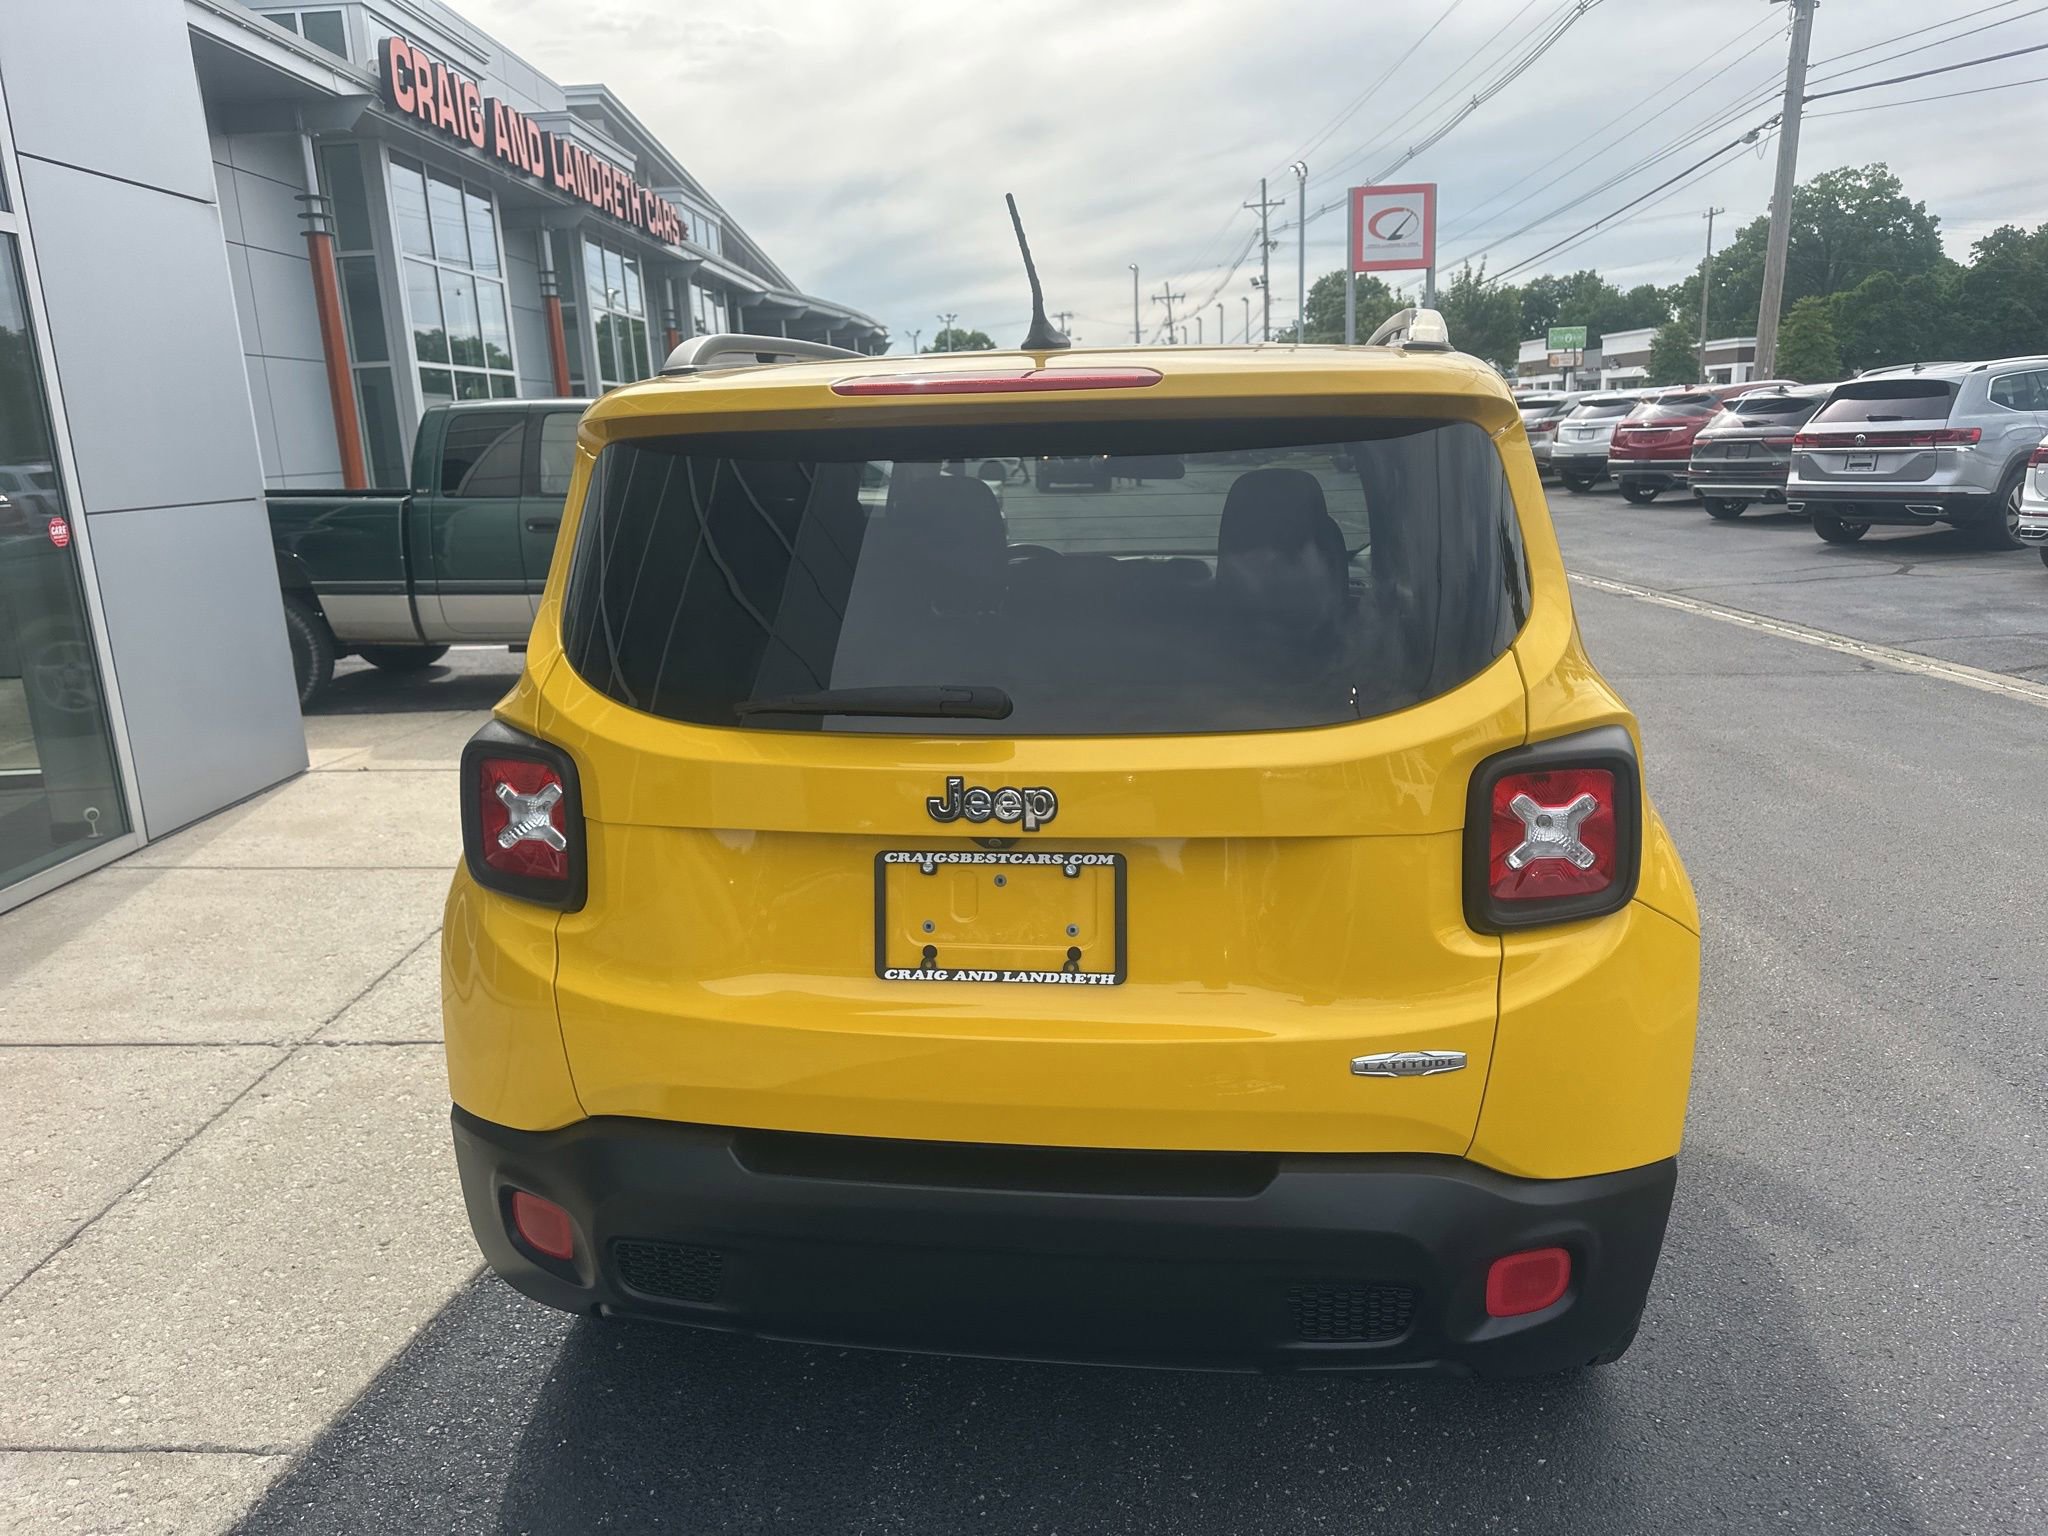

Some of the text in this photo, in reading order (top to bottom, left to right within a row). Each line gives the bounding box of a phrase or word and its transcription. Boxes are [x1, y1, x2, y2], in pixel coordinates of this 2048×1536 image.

[384, 36, 680, 246] CRAIG AND LANDRETH CARS
[927, 776, 1058, 831] Jeep
[884, 852, 1115, 865] CRAIGSBESTCARS.COM
[884, 969, 1115, 985] CRAIG AND LANDRETH
[1363, 1058, 1457, 1070] LATITUDE
